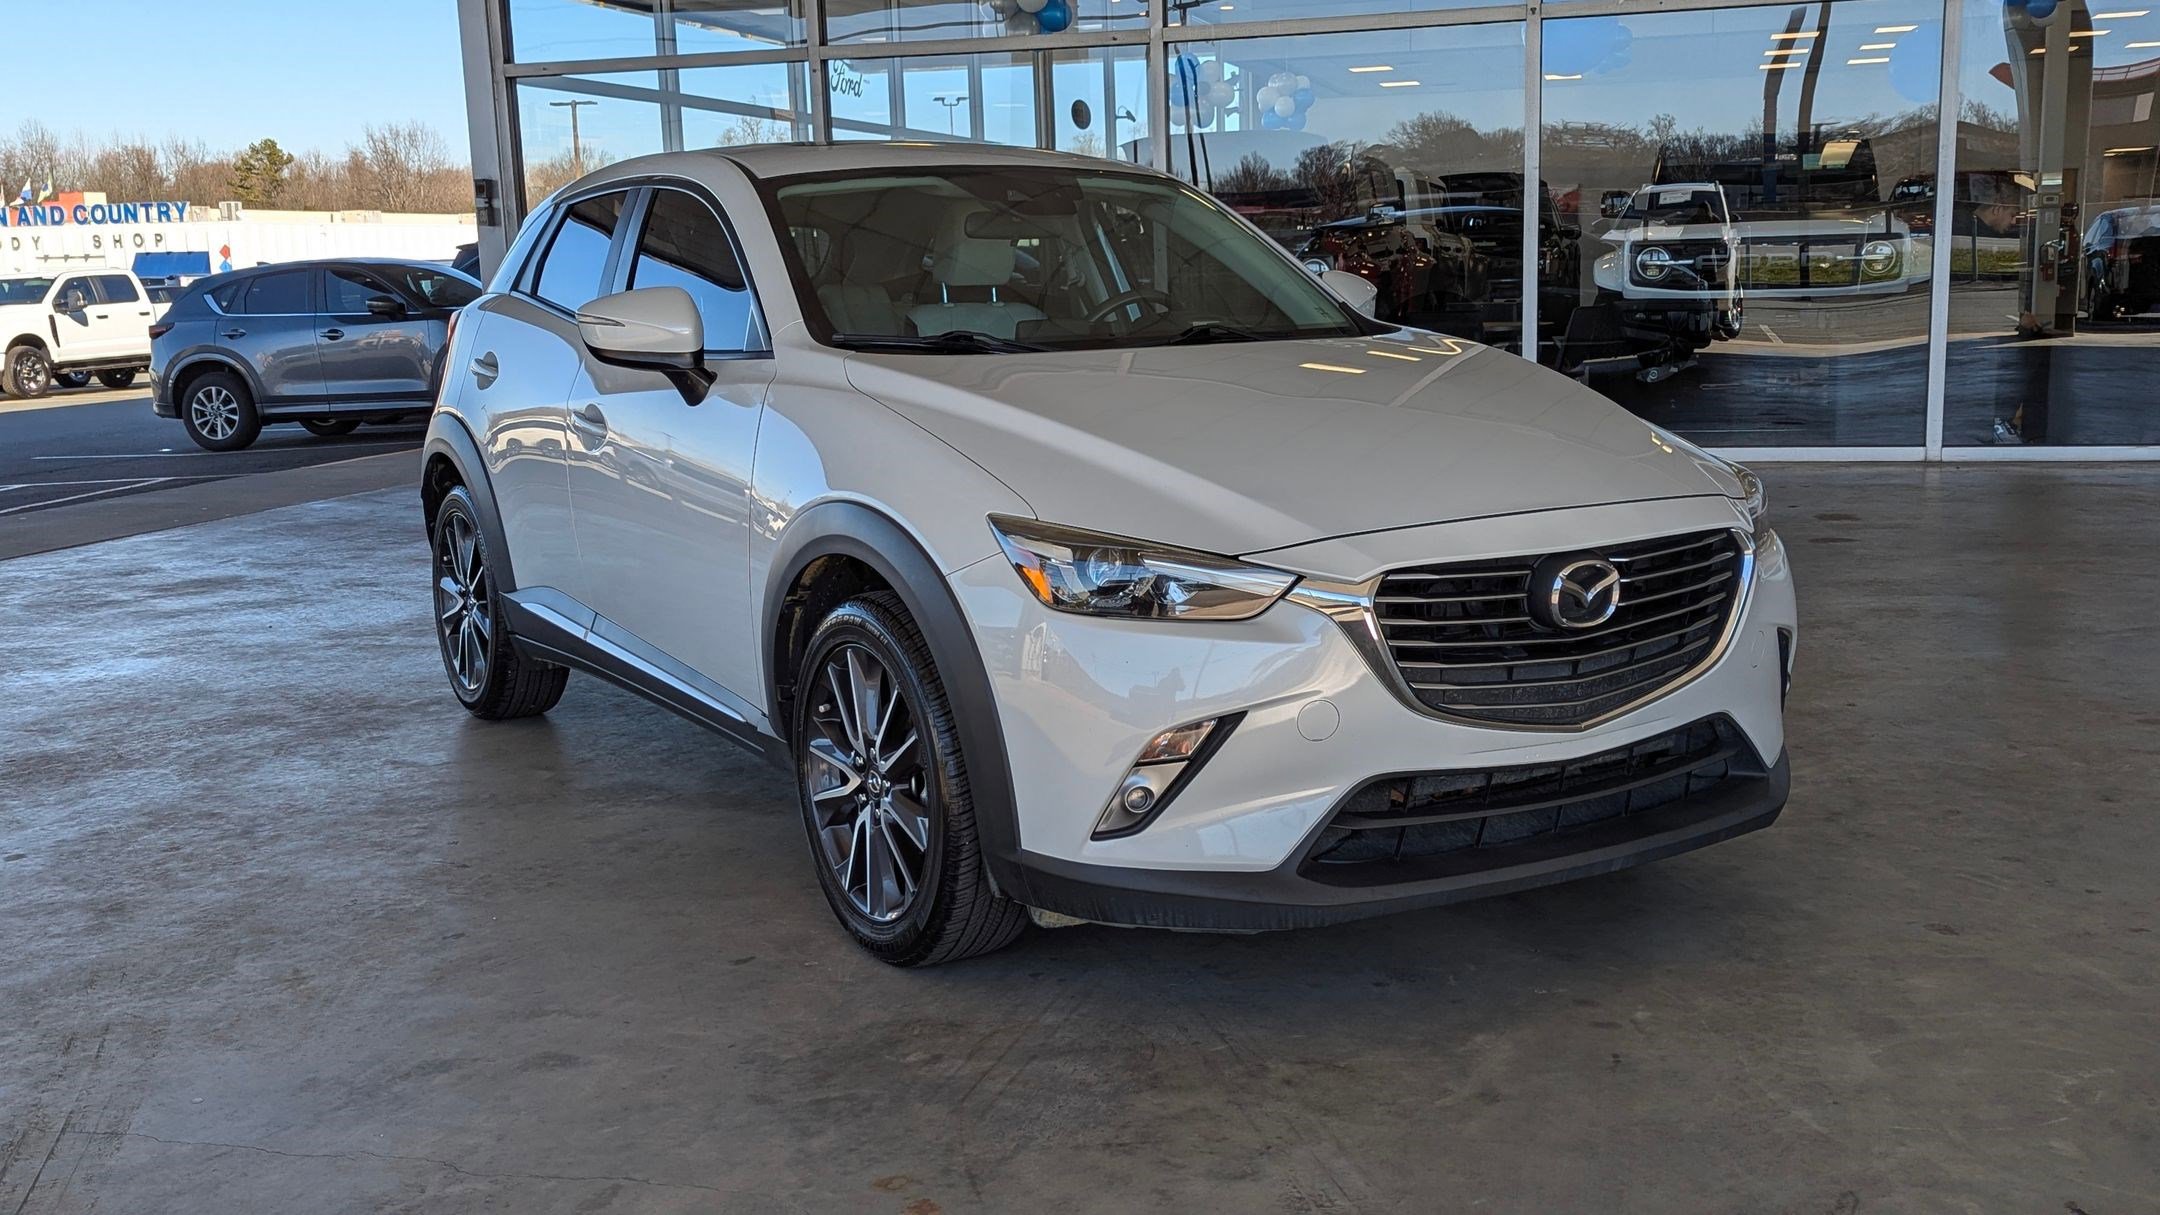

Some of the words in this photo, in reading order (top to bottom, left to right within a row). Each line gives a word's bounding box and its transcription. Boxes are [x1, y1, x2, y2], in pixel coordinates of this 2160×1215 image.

[831, 59, 863, 97] Ford
[17, 206, 65, 226] AND
[73, 203, 188, 225] COUNTRY
[0, 236, 40, 251] DY
[92, 234, 163, 249] SHOP
